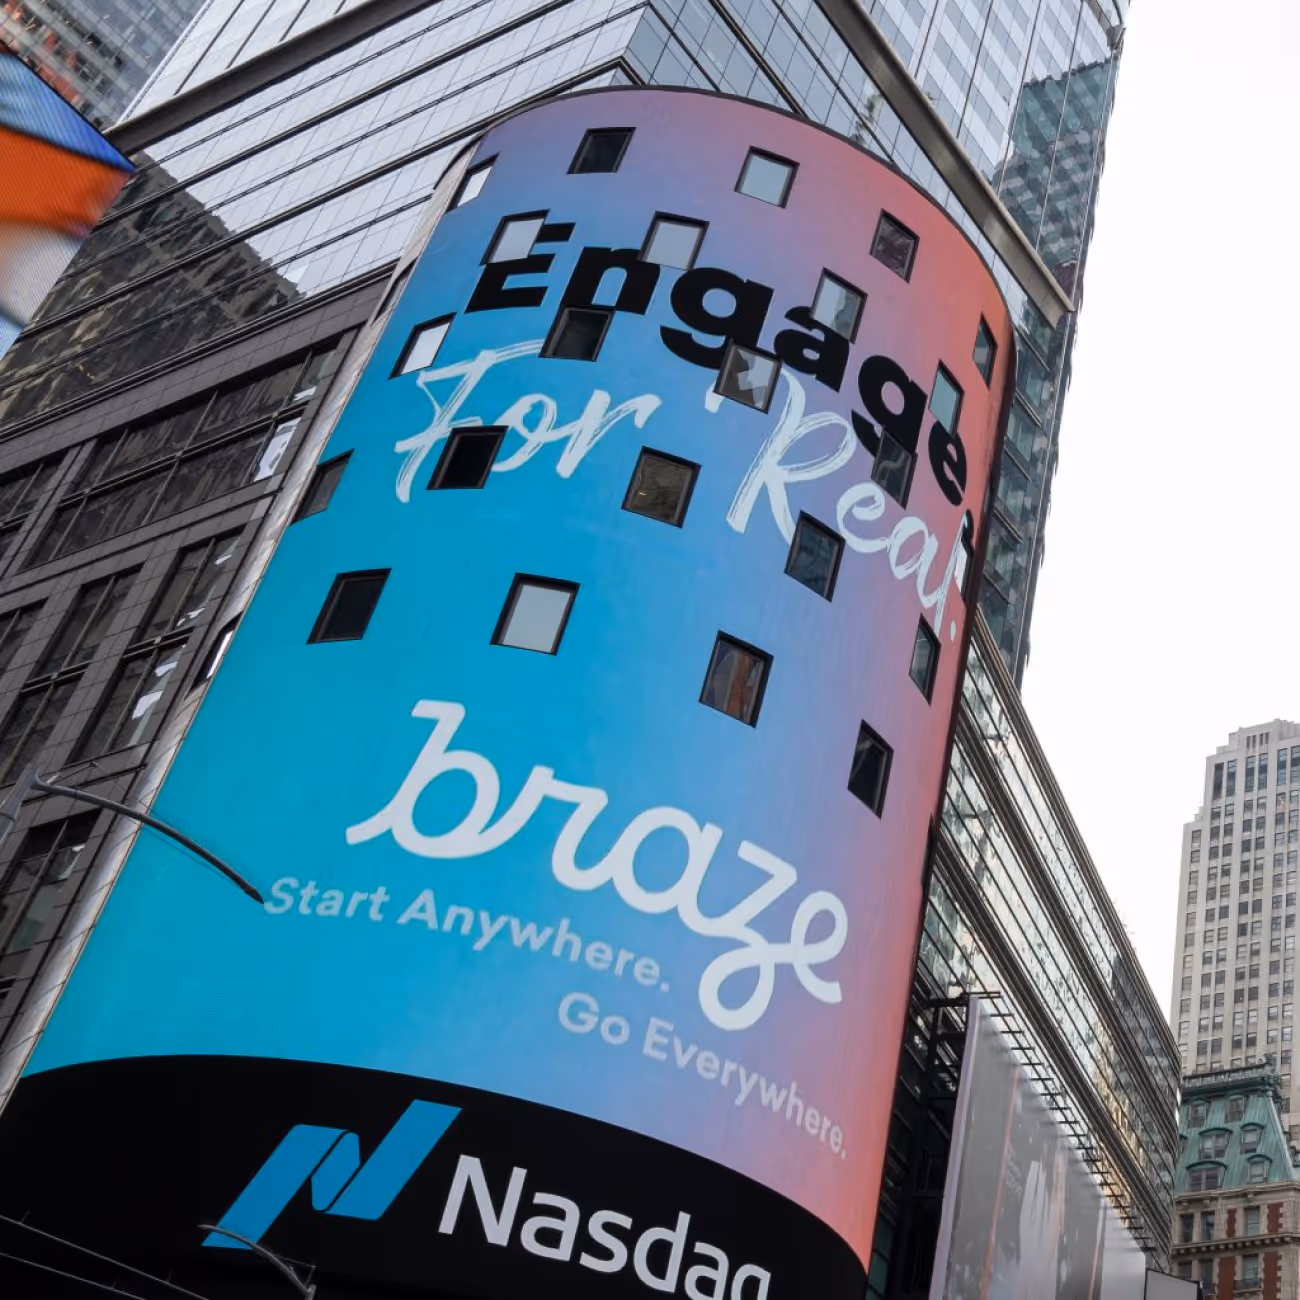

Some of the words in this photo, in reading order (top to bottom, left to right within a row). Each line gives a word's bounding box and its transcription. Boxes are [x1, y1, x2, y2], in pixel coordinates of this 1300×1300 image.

[394, 340, 662, 503] For
[705, 360, 967, 639] Real.
[263, 876, 390, 921] Start
[397, 887, 671, 992] Anywhere.
[345, 700, 848, 1031] braze
[557, 992, 630, 1046] Go
[643, 1024, 848, 1159] Everywhere.
